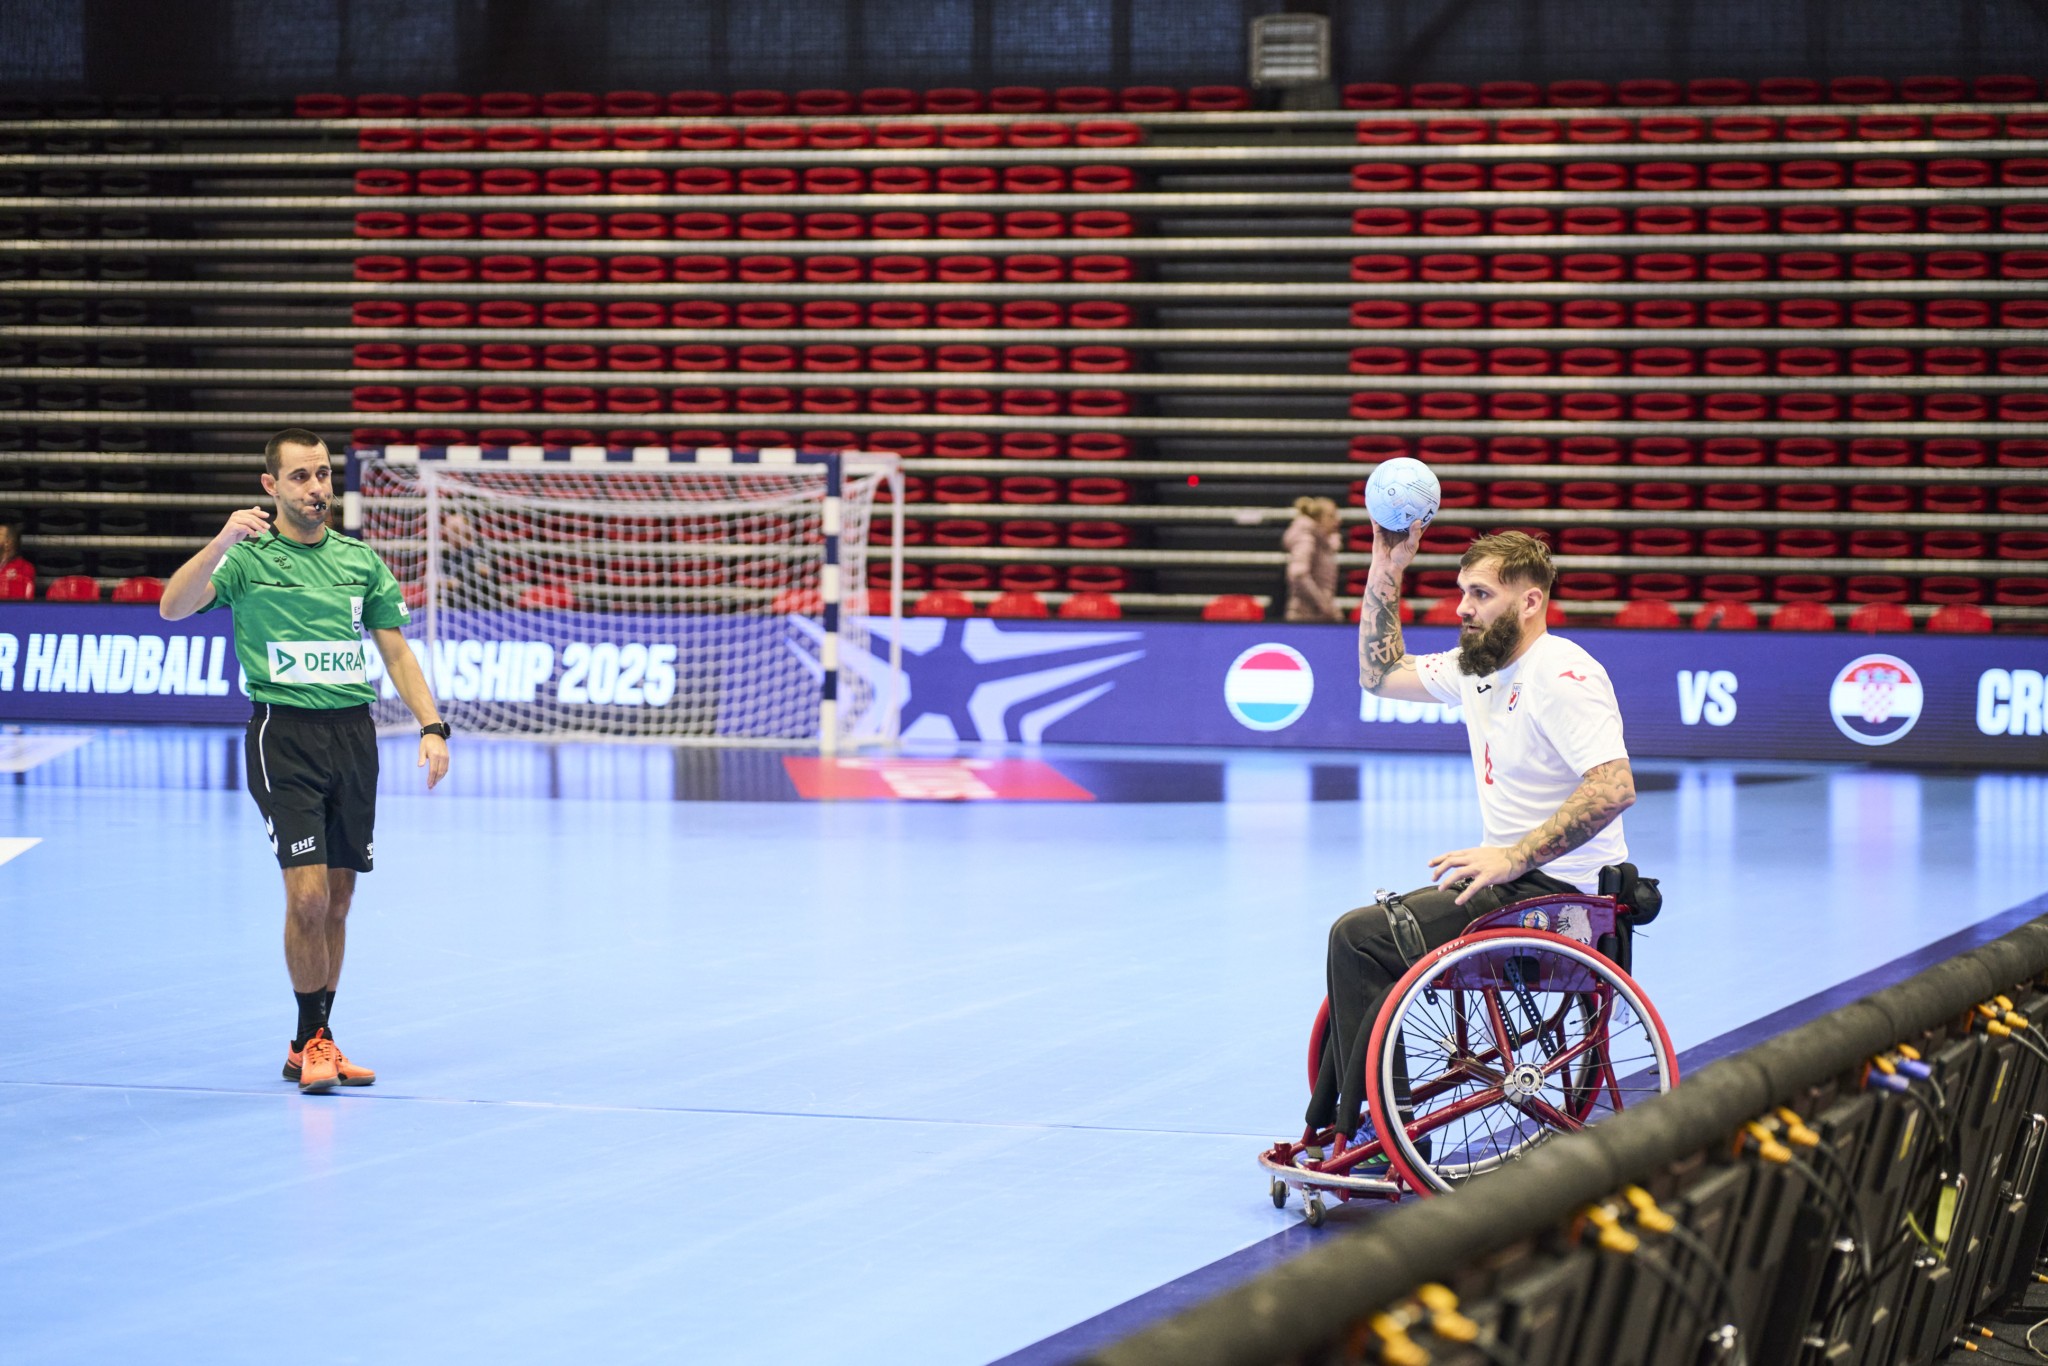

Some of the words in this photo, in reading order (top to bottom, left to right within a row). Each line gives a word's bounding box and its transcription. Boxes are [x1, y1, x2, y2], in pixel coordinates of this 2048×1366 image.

[23, 633, 229, 696] HANDBALL
[557, 641, 677, 706] 2025
[304, 652, 362, 671] DEKRA
[1677, 669, 1738, 727] VS
[1976, 668, 2048, 736] CR
[291, 836, 315, 854] EHF
